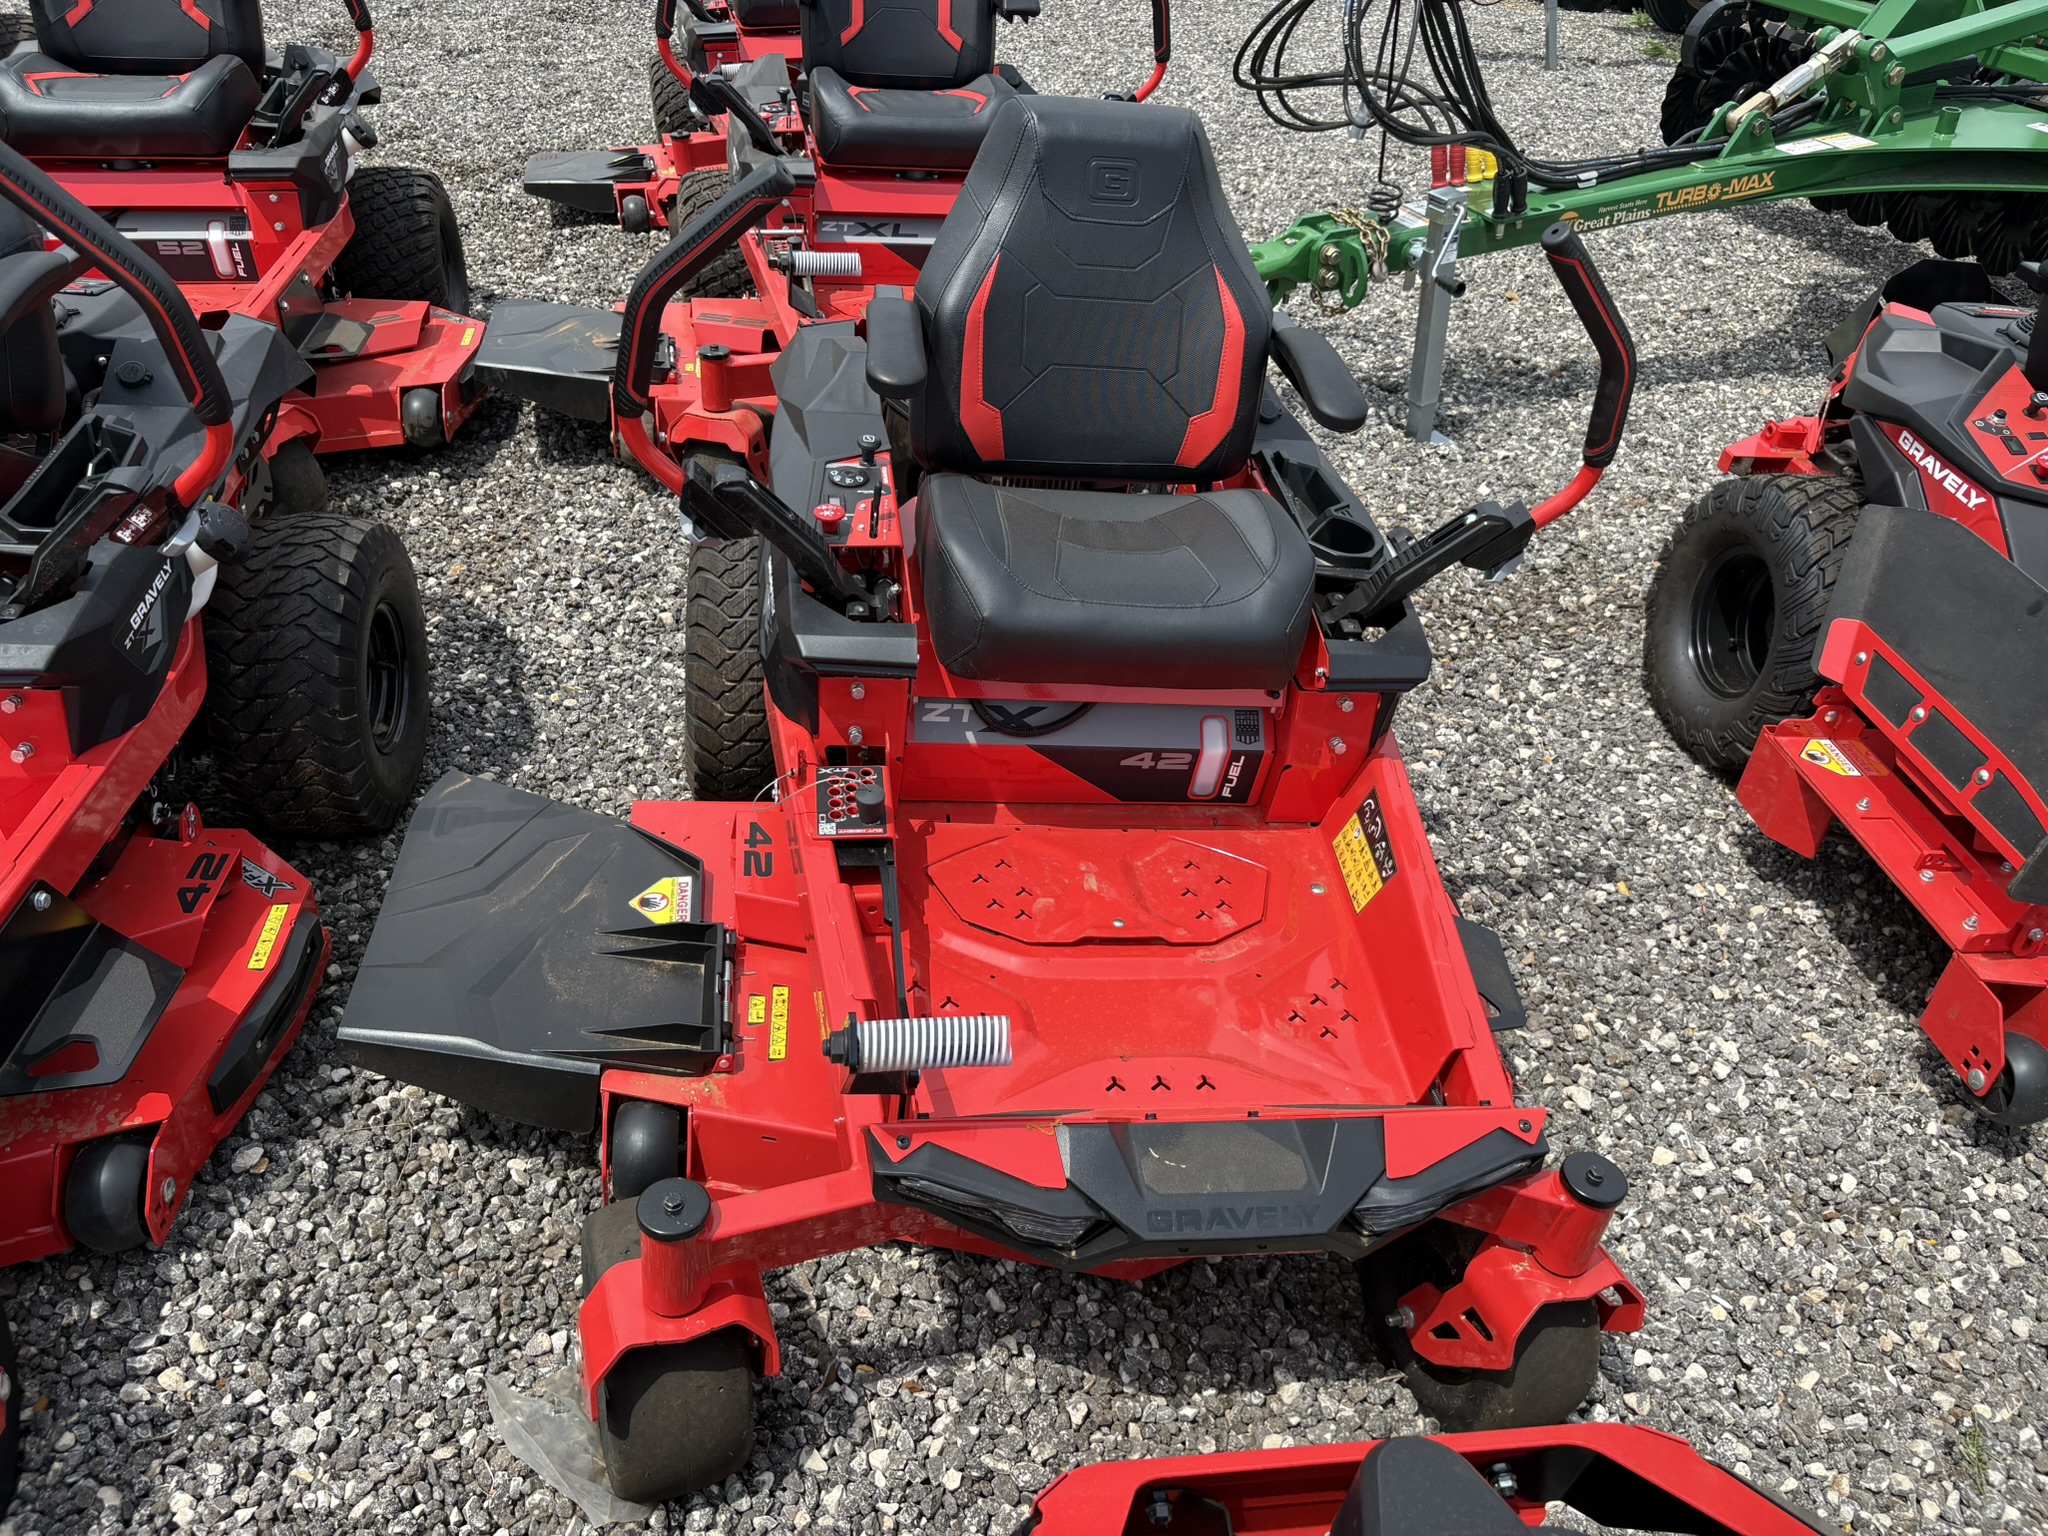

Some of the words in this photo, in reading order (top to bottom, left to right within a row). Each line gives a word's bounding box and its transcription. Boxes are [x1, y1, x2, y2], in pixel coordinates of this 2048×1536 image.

[1619, 200, 1634, 210] Starts
[1635, 198, 1648, 207] Here
[821, 221, 855, 232] ZT
[1572, 214, 1610, 232] Great
[1612, 208, 1651, 225] Plains
[156, 241, 205, 255] 52
[231, 242, 248, 277] FUEL
[1898, 430, 1988, 508] GRAVELY
[129, 558, 173, 631] GRAVELY
[921, 702, 973, 723] ZT
[1120, 752, 1193, 770] 42
[1824, 743, 1855, 772] DANGER
[1221, 755, 1246, 798] FUEL
[744, 822, 773, 877] 42
[177, 853, 230, 914] 42
[676, 881, 689, 922] DANGER
[1146, 1204, 1321, 1233] GRAVELY
